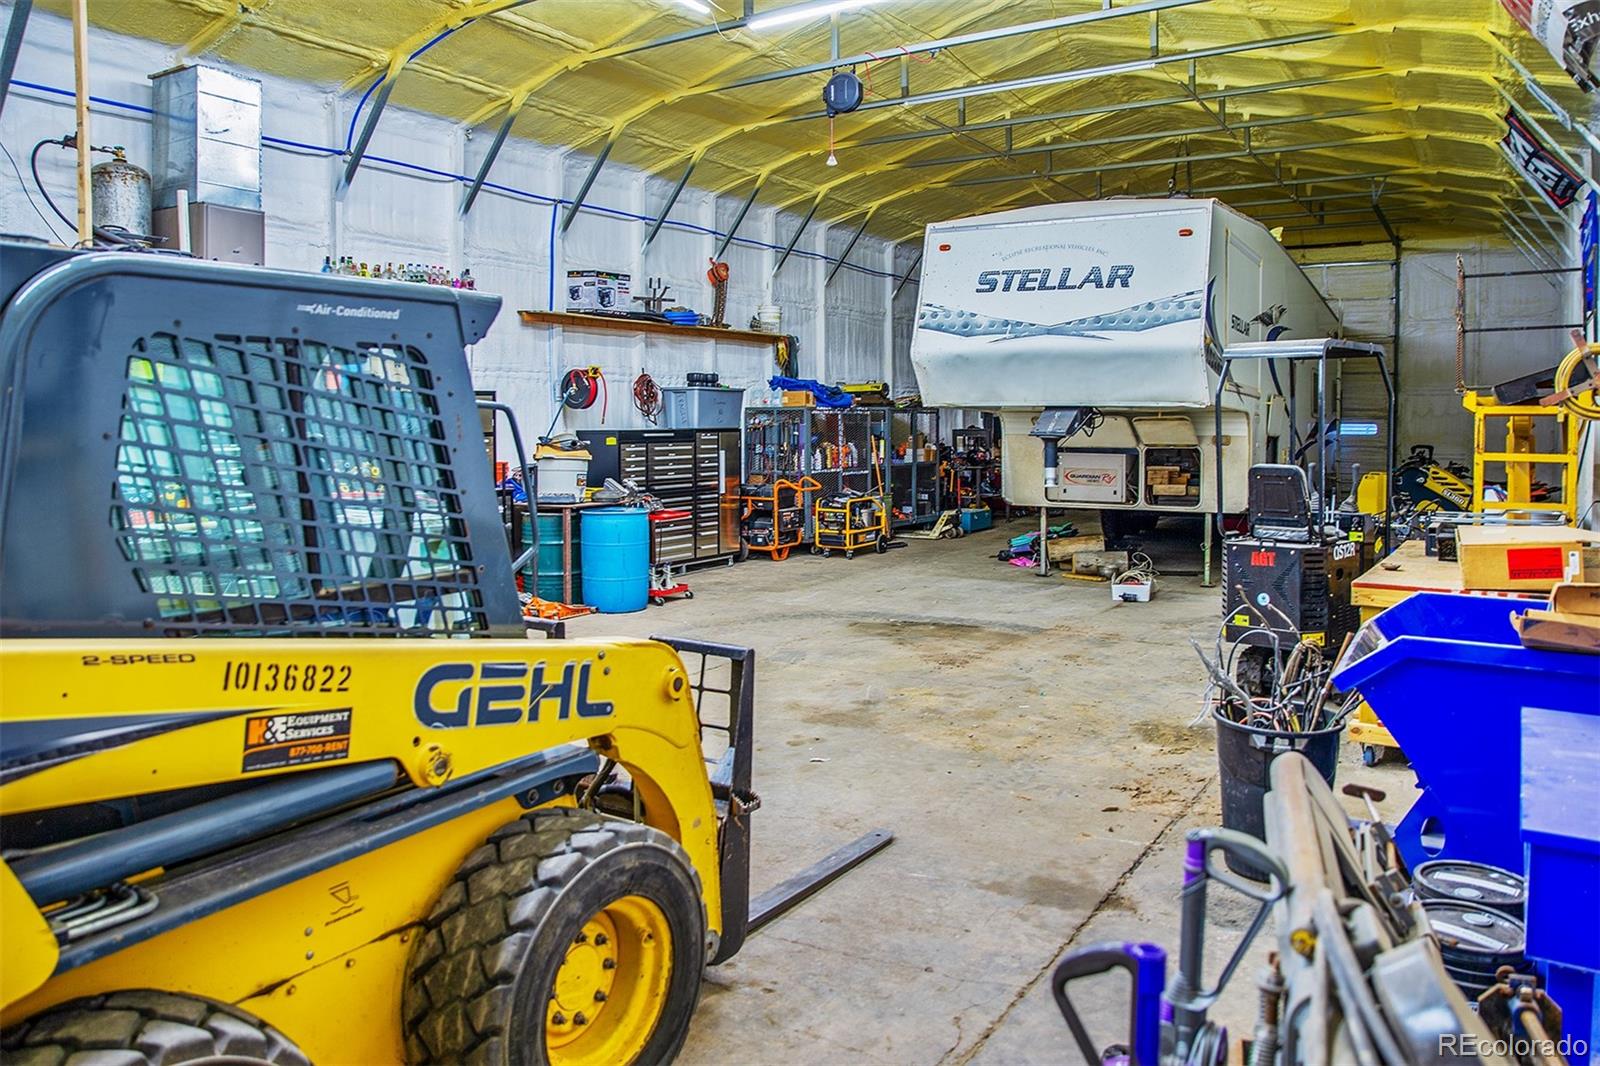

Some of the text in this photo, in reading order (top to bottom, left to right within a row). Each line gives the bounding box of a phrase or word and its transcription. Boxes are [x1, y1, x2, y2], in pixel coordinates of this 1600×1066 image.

[975, 264, 1135, 293] STELLAR
[315, 304, 400, 320] Air-Conditioned
[1232, 314, 1250, 336] STELLAR
[1250, 550, 1277, 567] AGT
[81, 652, 196, 667] 2-SPEED
[222, 660, 353, 692] 10136822
[414, 660, 614, 730] GEHL
